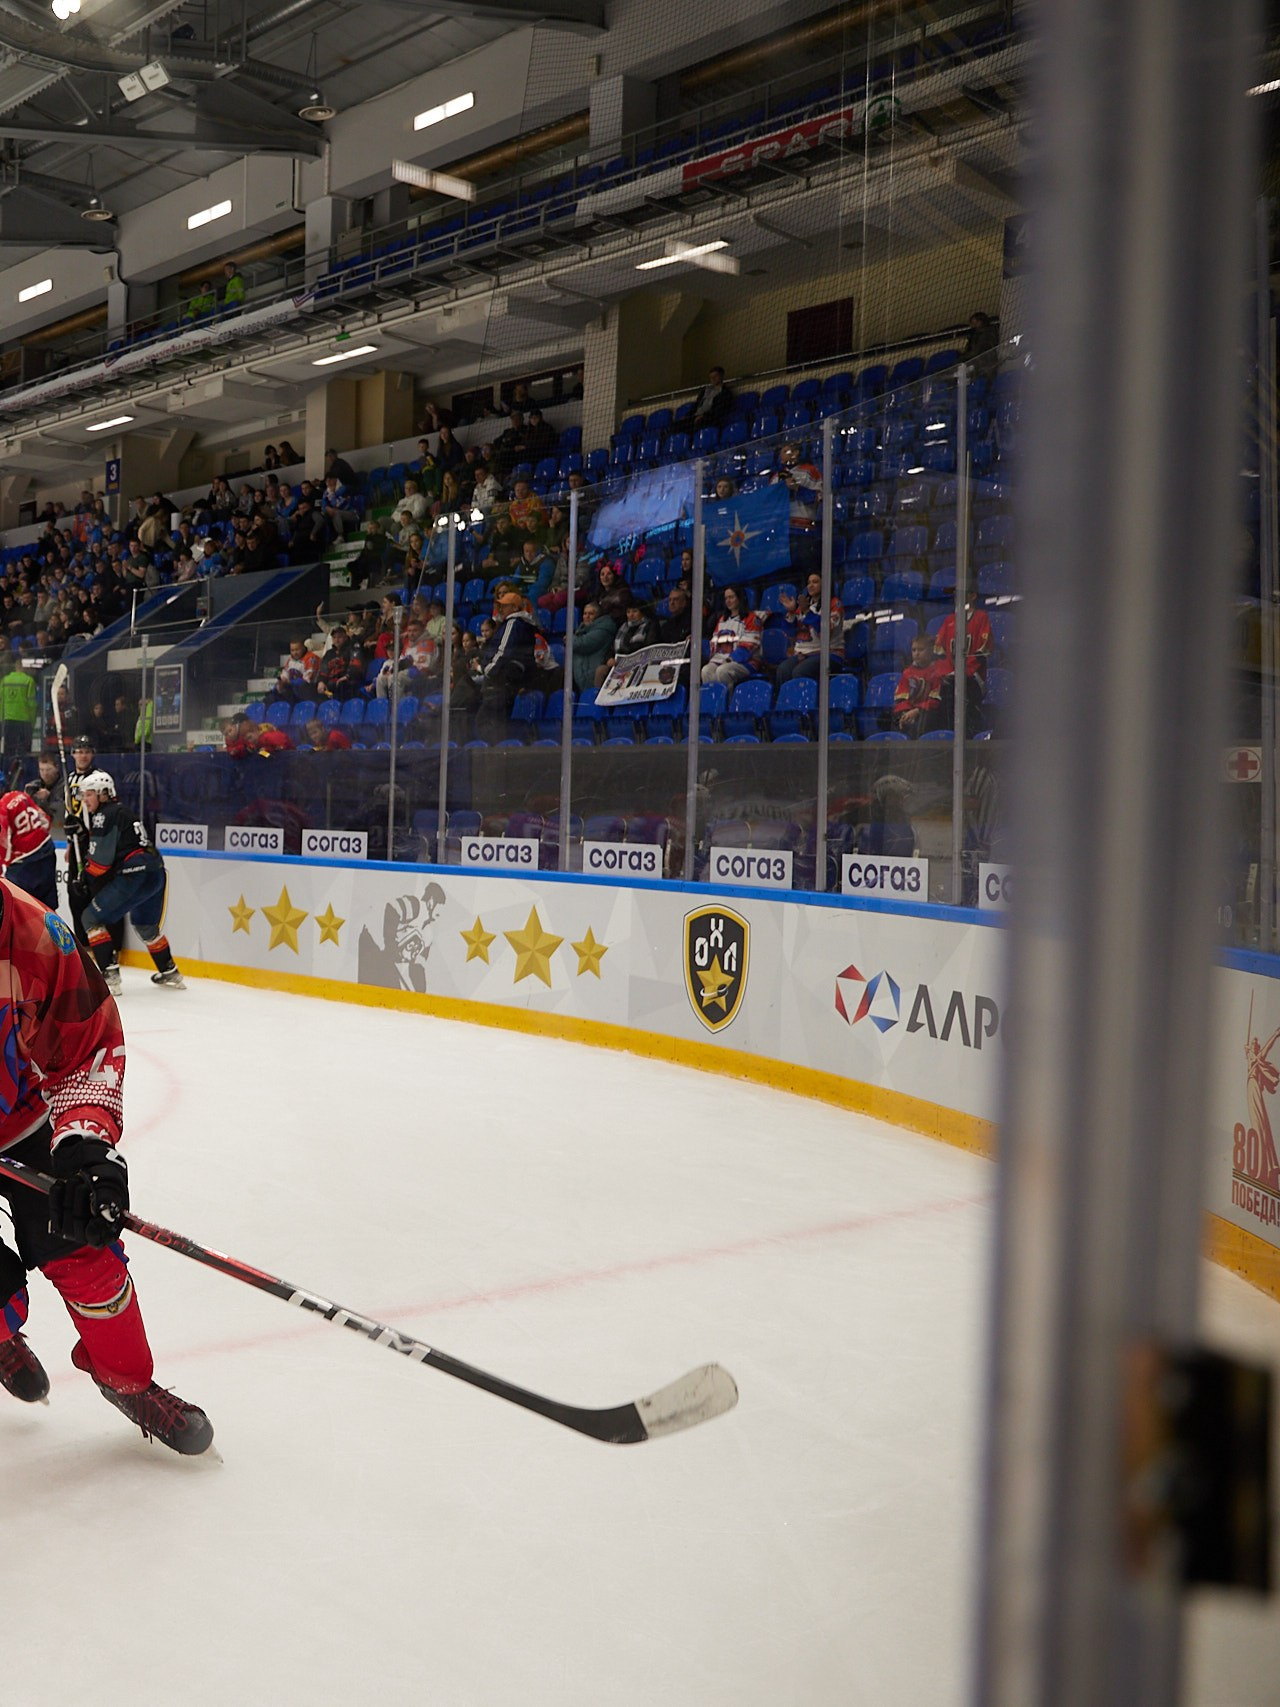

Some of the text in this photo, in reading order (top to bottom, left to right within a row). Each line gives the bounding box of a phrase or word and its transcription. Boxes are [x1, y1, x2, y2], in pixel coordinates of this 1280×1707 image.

[109, 463, 118, 481] 3
[906, 983, 1001, 1051] АЛР
[1233, 1122, 1262, 1178] 80
[288, 1289, 432, 1362] CCM
